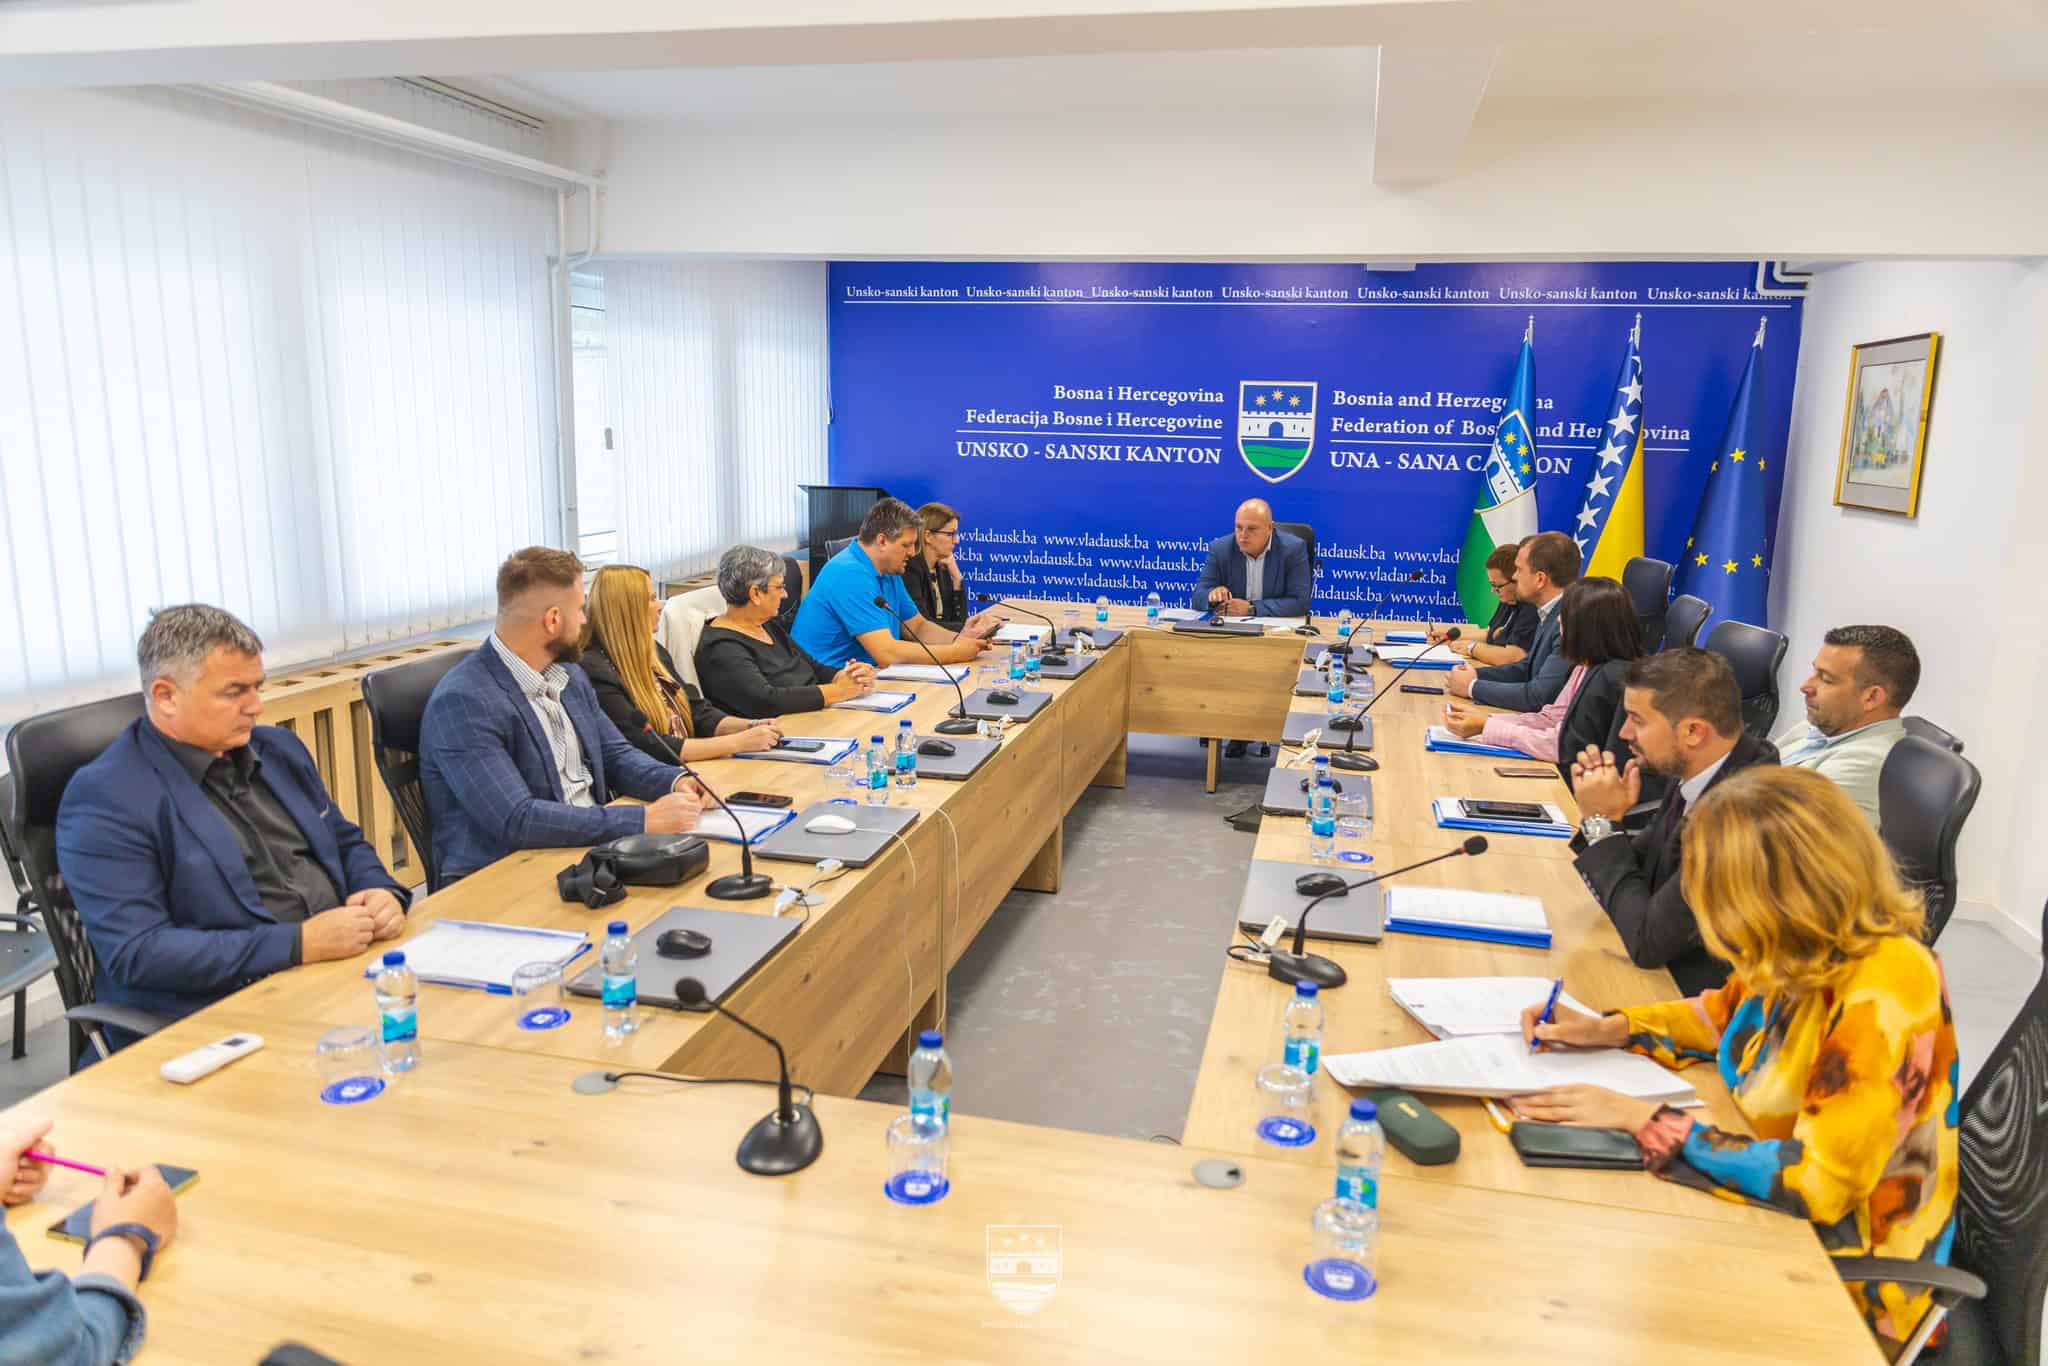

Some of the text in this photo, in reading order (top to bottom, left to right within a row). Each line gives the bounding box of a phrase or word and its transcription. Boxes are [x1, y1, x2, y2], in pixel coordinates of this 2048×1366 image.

[846, 285, 918, 297] Unsko-sanski
[920, 285, 959, 297] kanton
[966, 285, 1040, 298] Unsko-sanski
[1044, 285, 1084, 298] kanton
[1090, 286, 1169, 298] Unsko-sanski
[1172, 286, 1214, 298] kanton
[1222, 286, 1303, 299] Unsko-sanski
[1304, 286, 1349, 299] kanton
[1358, 287, 1442, 299] Unsko-sanski
[1444, 287, 1489, 299] kanton
[1499, 287, 1587, 300] Unsko-sanski
[1590, 287, 1637, 300] kanton
[1647, 287, 1739, 300] Unsko-sanski
[1054, 385, 1225, 406] Bosna i Hercegovina
[1332, 390, 1554, 413] Bosnia and Herzega
[965, 408, 1223, 432] Federacija Bosne i Hercegovine
[1331, 417, 1428, 434] Federation
[1434, 419, 1455, 435] of
[1535, 422, 1564, 438] nd
[1568, 422, 1691, 441] Hervina
[956, 441, 1029, 458] UNSKO
[1045, 443, 1121, 461] SANSKI
[1126, 445, 1222, 464] KANTON
[1329, 450, 1380, 468] UNA
[1397, 452, 1460, 471] SANA
[1466, 454, 1573, 475] CON
[958, 528, 1037, 544] w.vladausk.ba
[1044, 531, 1149, 550] www.vladausk.ba
[1314, 542, 1386, 560] ladausk.ba
[990, 550, 1093, 567] www.vladausk.ba
[1332, 566, 1448, 585] www.vladak.ba
[960, 567, 1036, 584] .vladausk.ba
[1043, 572, 1148, 590] www.vladausk.ba
[1311, 583, 1383, 602] ladausk.ba
